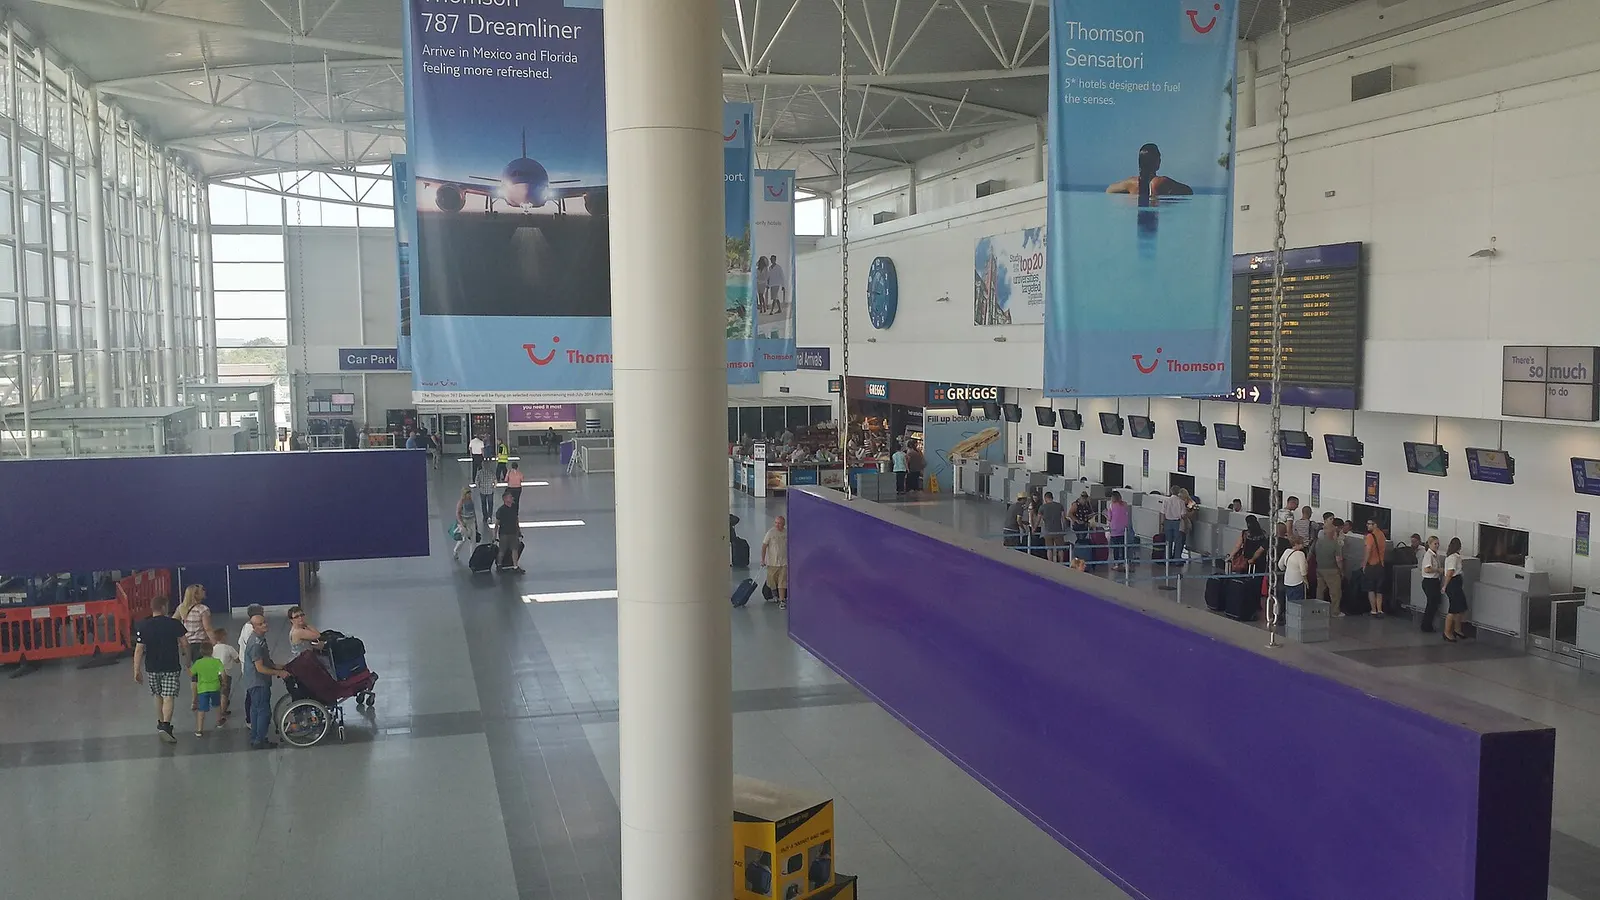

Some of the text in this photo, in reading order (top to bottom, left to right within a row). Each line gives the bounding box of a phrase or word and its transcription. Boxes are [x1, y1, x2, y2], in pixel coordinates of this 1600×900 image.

[421, 12, 582, 39] 787 Dreamliner
[1066, 21, 1144, 43] Thomson
[422, 44, 578, 63] Arrive in Mexico and Florida
[1065, 47, 1144, 69] Sensatori
[422, 62, 552, 79] feeling more refreshed.
[1078, 78, 1107, 90] hotels
[1109, 80, 1149, 92] designed
[1152, 82, 1161, 92] to
[1163, 81, 1181, 92] fuel
[1064, 93, 1116, 105] the senses.
[1020, 252, 1043, 275] top20
[347, 354, 396, 364] Car Park
[804, 352, 823, 367] Arrivals
[1166, 359, 1225, 372] Thomson
[1511, 355, 1535, 365] There's
[1529, 363, 1587, 379] so much
[869, 384, 886, 397] GREGGS
[947, 387, 997, 400] GREGGS
[1548, 387, 1568, 396] to do
[940, 416, 951, 424] up
[952, 414, 975, 422] before
[976, 416, 985, 424] yo
